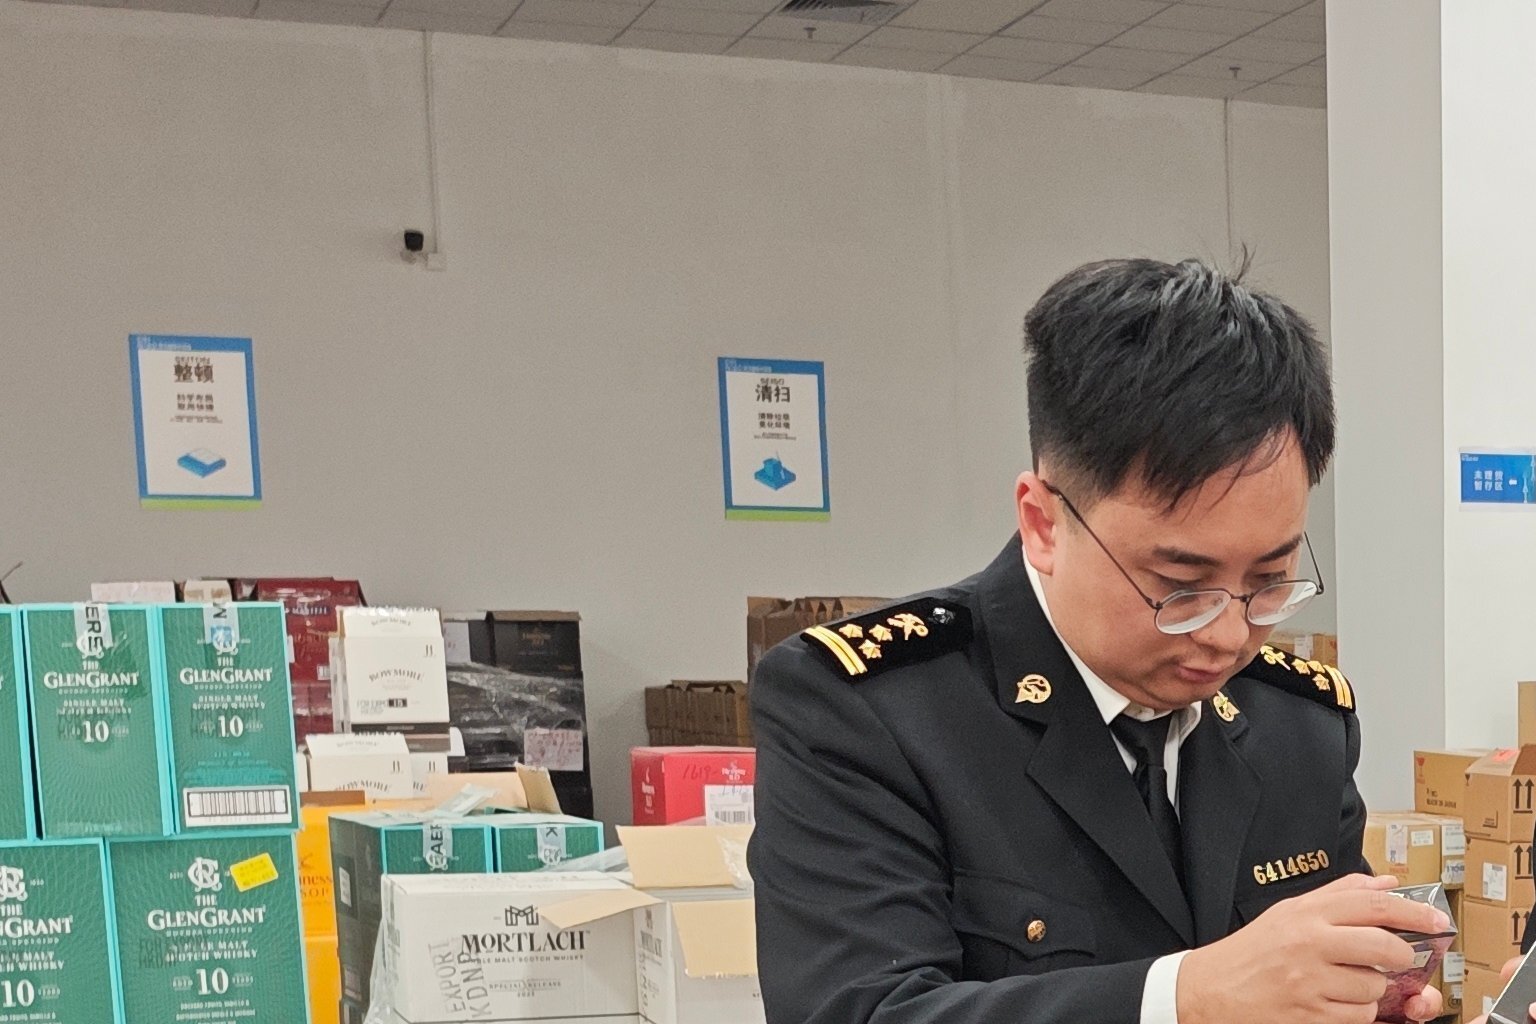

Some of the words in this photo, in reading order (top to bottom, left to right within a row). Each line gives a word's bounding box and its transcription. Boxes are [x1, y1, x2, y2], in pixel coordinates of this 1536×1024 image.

[174, 364, 214, 383] 整顿
[755, 384, 791, 403] 清扫
[82, 720, 109, 743] 10
[217, 715, 244, 738] 10
[1253, 849, 1330, 885] 6414650
[1, 904, 23, 916] THE
[195, 895, 218, 907] THE
[461, 930, 586, 954] MORTLACH
[1, 979, 35, 1007] 10
[196, 967, 229, 996] 10
